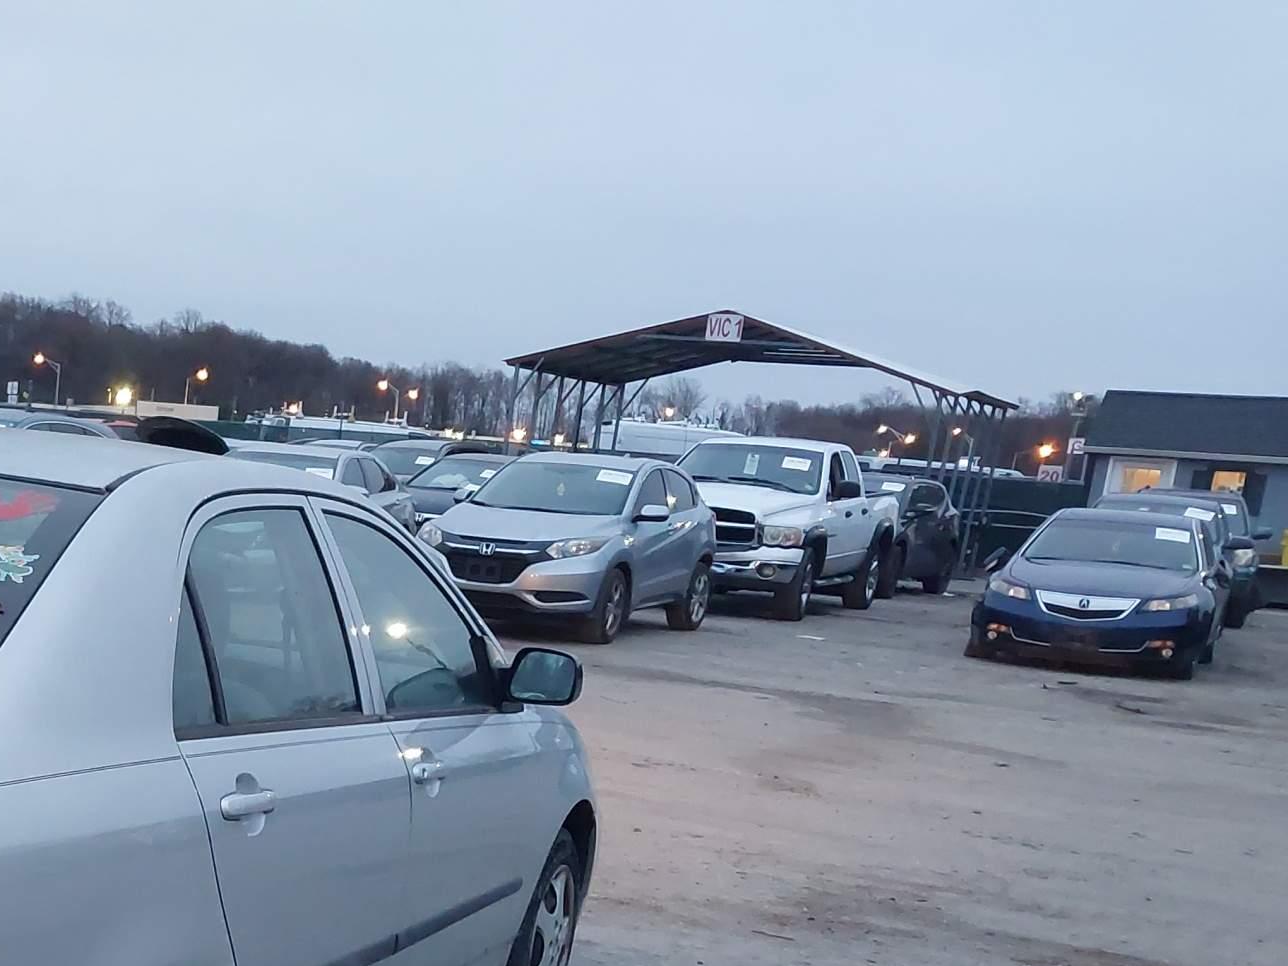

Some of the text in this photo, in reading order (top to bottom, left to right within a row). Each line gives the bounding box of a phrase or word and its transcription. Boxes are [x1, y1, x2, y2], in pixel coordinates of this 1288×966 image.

[709, 317, 743, 339] VIC 1
[1040, 470, 1060, 481] 20
